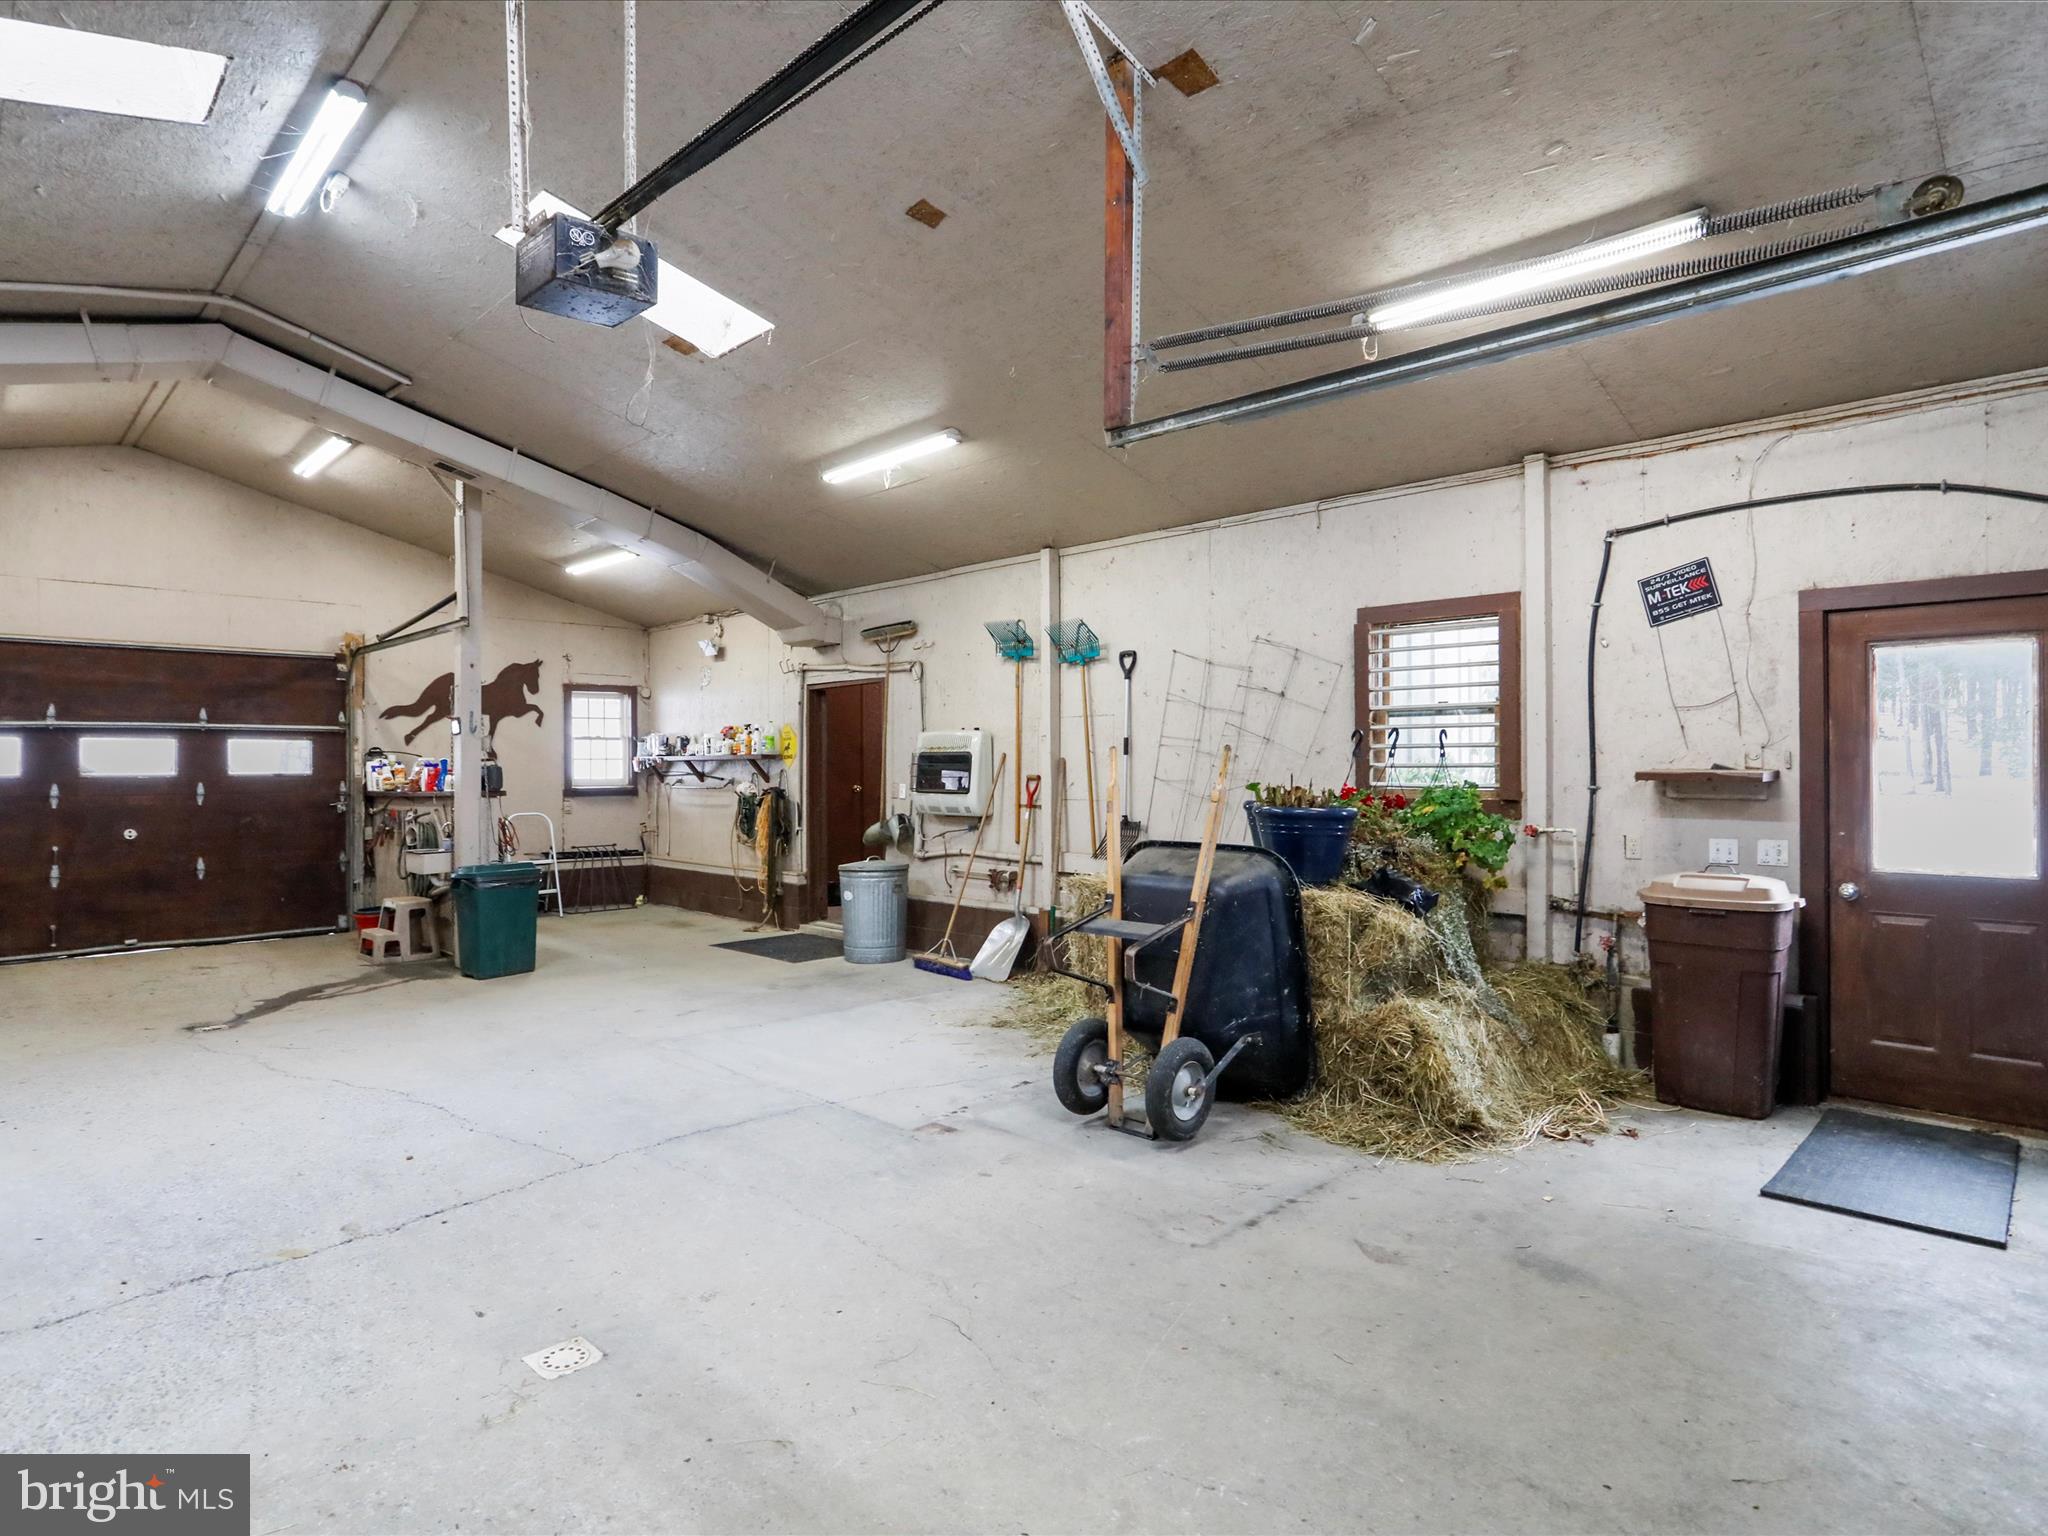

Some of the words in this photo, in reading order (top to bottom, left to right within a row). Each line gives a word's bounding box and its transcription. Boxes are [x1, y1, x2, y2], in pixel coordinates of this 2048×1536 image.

[1644, 567, 1706, 592] SURVEILLANCE
[1650, 574, 1671, 585] 24/7
[1672, 564, 1697, 577] VIDEO
[1671, 600, 1687, 610] GET
[1690, 592, 1713, 605] MTEK
